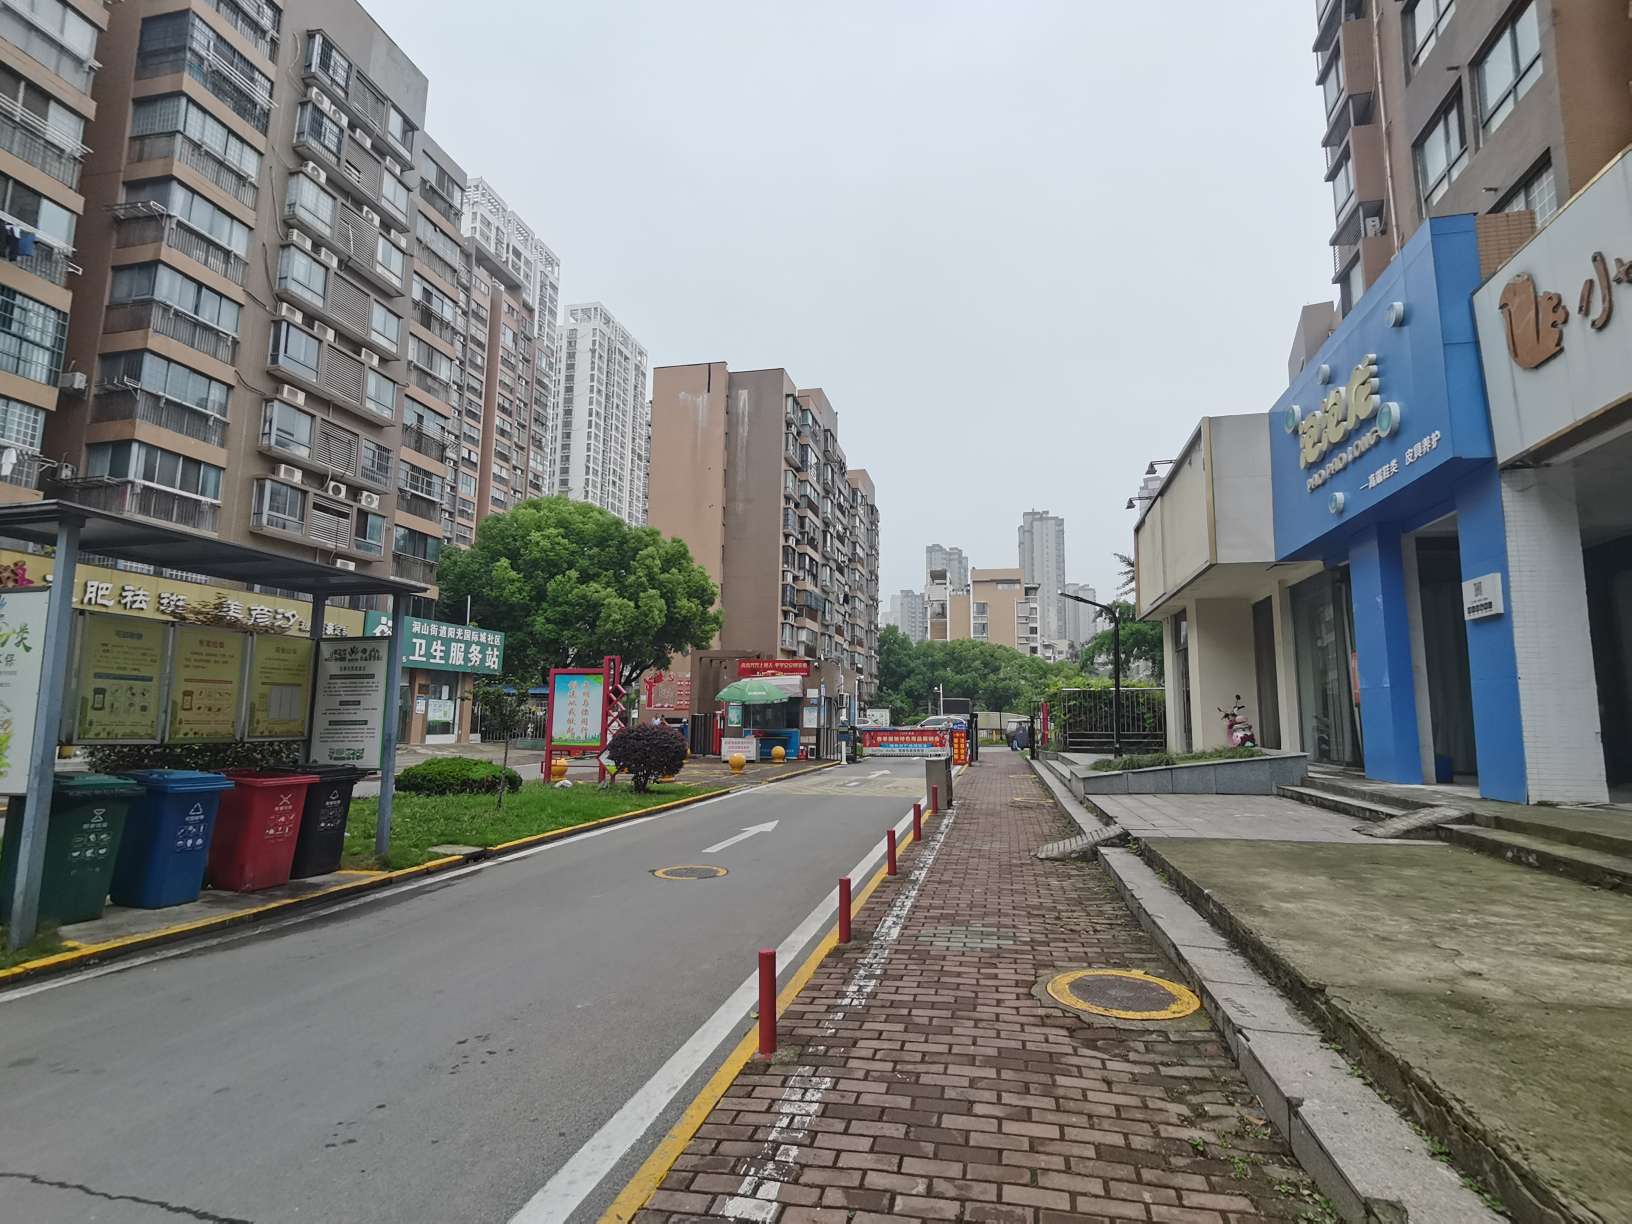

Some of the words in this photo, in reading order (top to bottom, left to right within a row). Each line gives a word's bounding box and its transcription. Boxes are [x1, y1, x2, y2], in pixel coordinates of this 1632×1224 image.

[45, 575, 187, 613] 肥祛斑
[412, 621, 501, 646] 洞山街道阳光国际城社区
[409, 638, 500, 670] 卫生服务站
